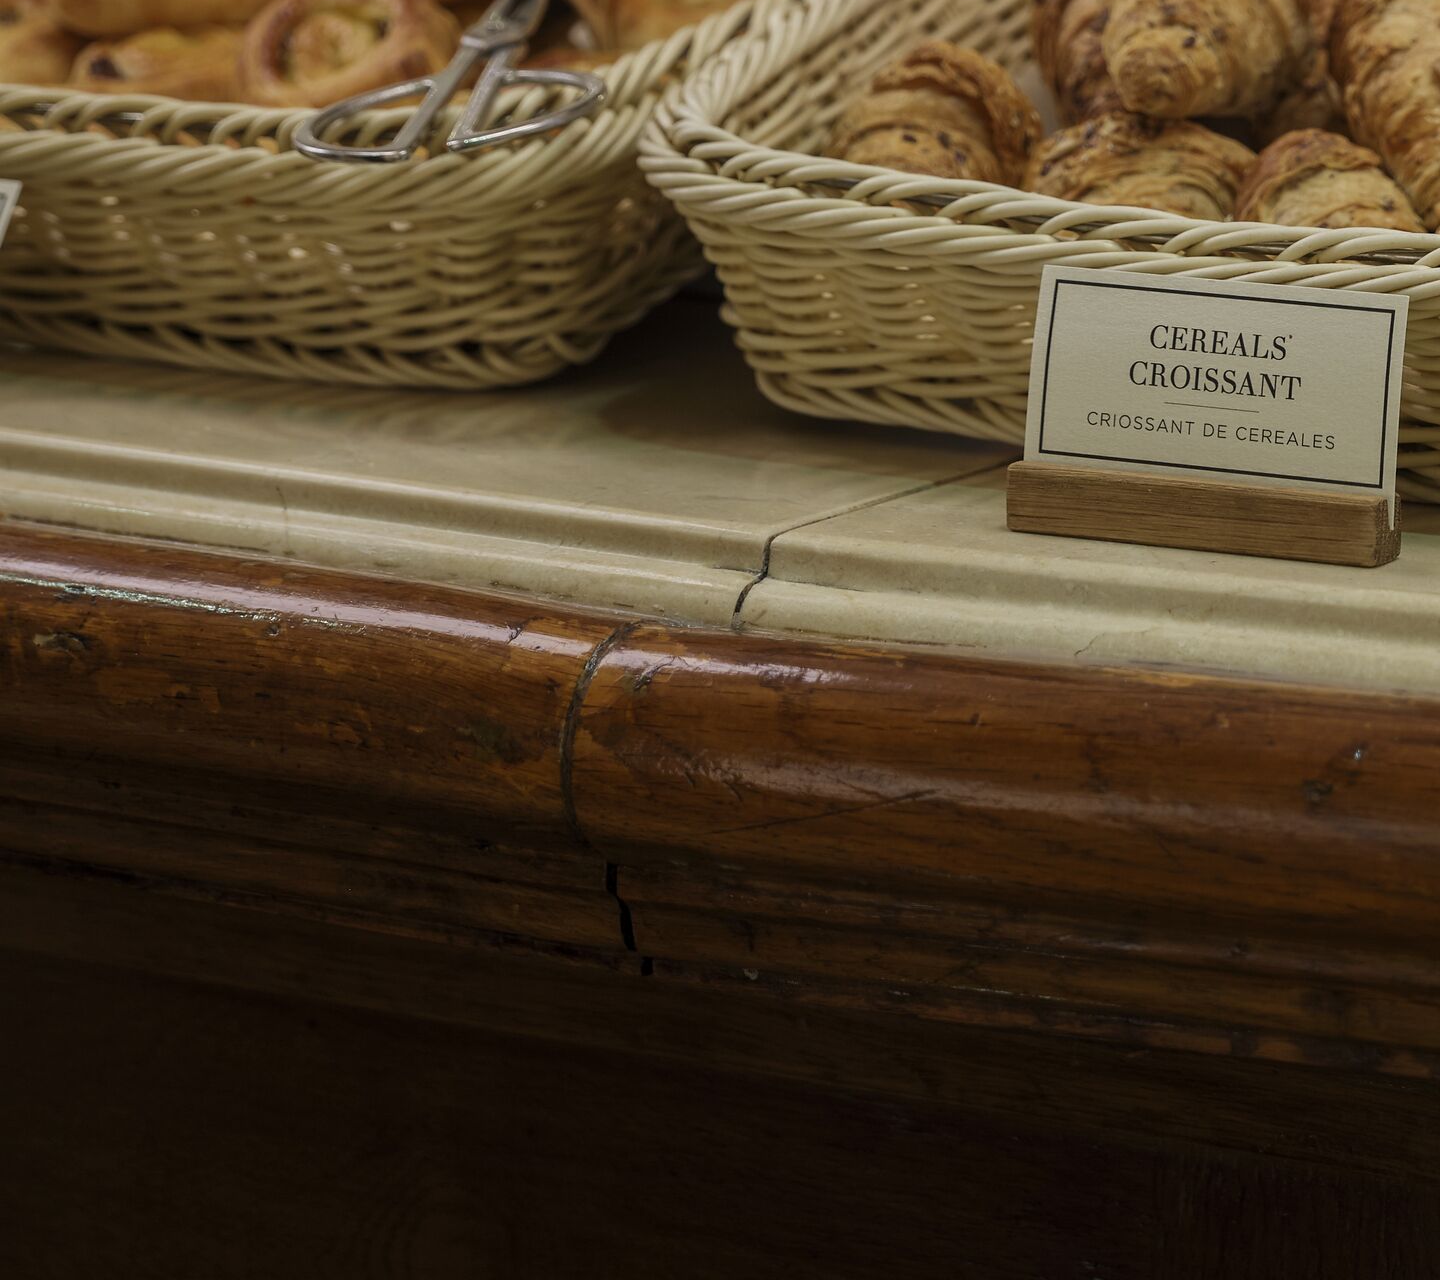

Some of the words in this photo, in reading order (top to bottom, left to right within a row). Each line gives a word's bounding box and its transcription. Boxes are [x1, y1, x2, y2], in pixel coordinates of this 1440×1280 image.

[1129, 360, 1302, 400] CROISSANT
[1086, 411, 1196, 436] CRIOSSANT
[1203, 422, 1228, 439] DE
[1235, 426, 1336, 450] CEREALES
